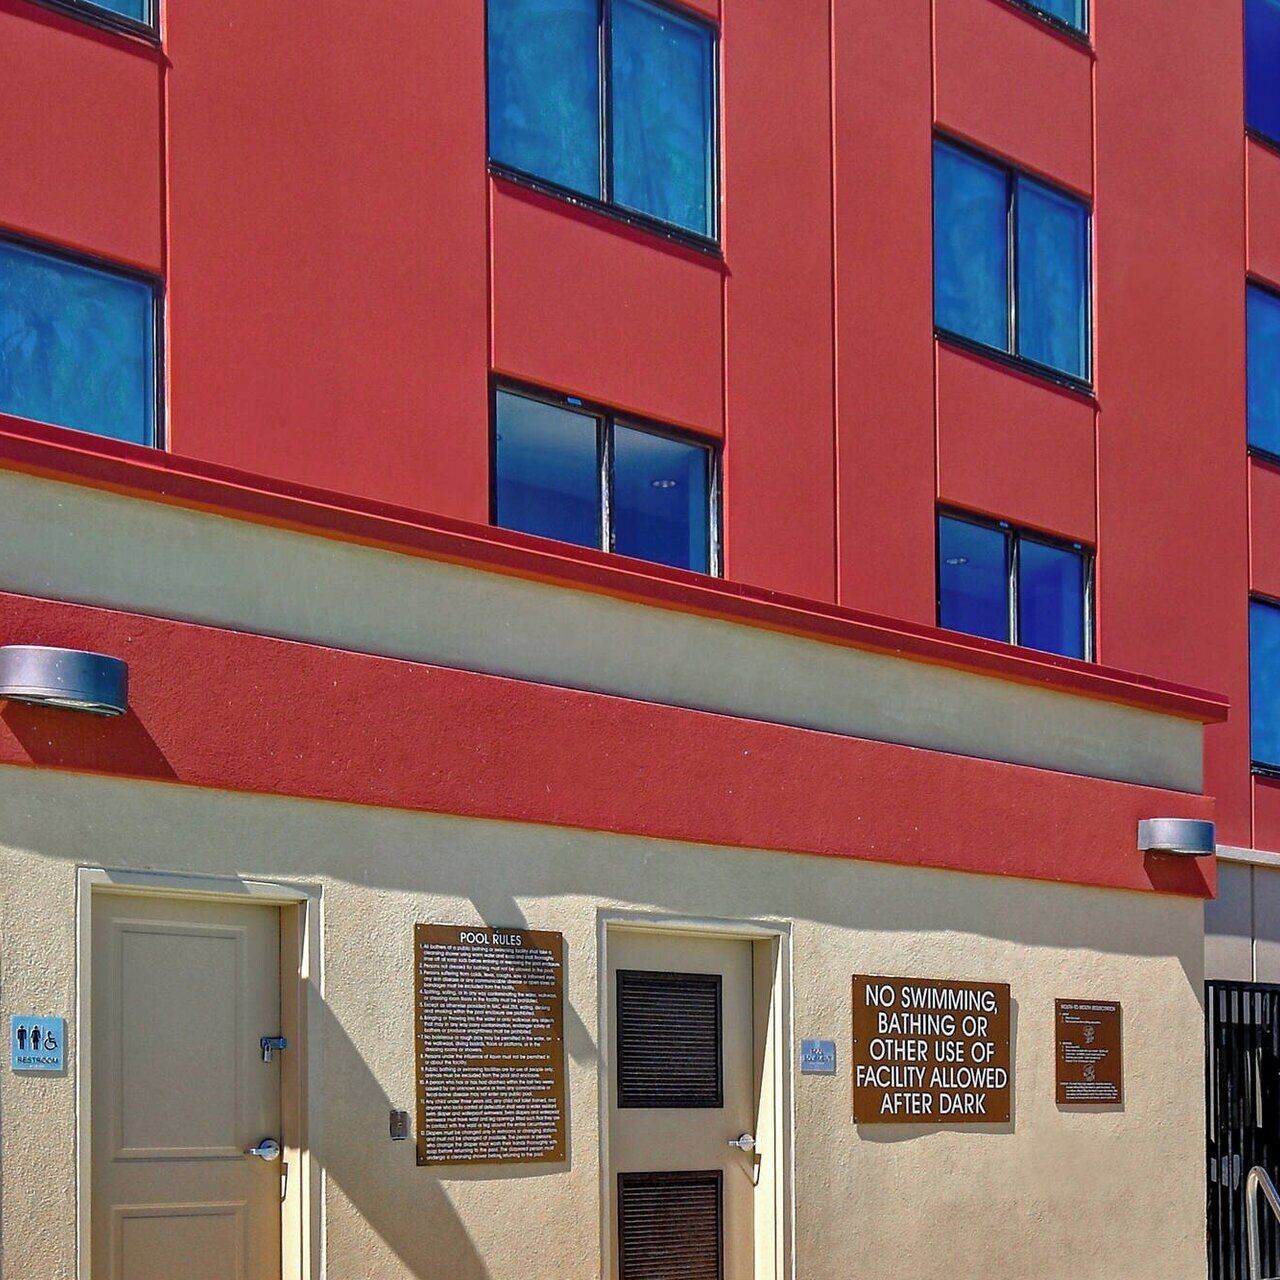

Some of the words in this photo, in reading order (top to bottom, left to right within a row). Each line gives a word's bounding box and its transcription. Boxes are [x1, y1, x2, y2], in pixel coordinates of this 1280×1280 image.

[460, 932, 490, 944] POOL
[492, 934, 523, 946] RULES
[865, 984, 895, 1008] NO
[901, 986, 998, 1015] SWIMMING,
[878, 1013, 955, 1036] BATHING
[961, 1015, 988, 1037] OR
[17, 1056, 59, 1065] RESTROOM
[869, 1038, 927, 1063] OTHER
[934, 1040, 965, 1063] USE
[971, 1041, 995, 1064] OF
[856, 1065, 926, 1089] FACILITY
[929, 1066, 1007, 1090] ALLOWED
[880, 1092, 932, 1115] AFTER
[939, 1092, 986, 1115] DARK
